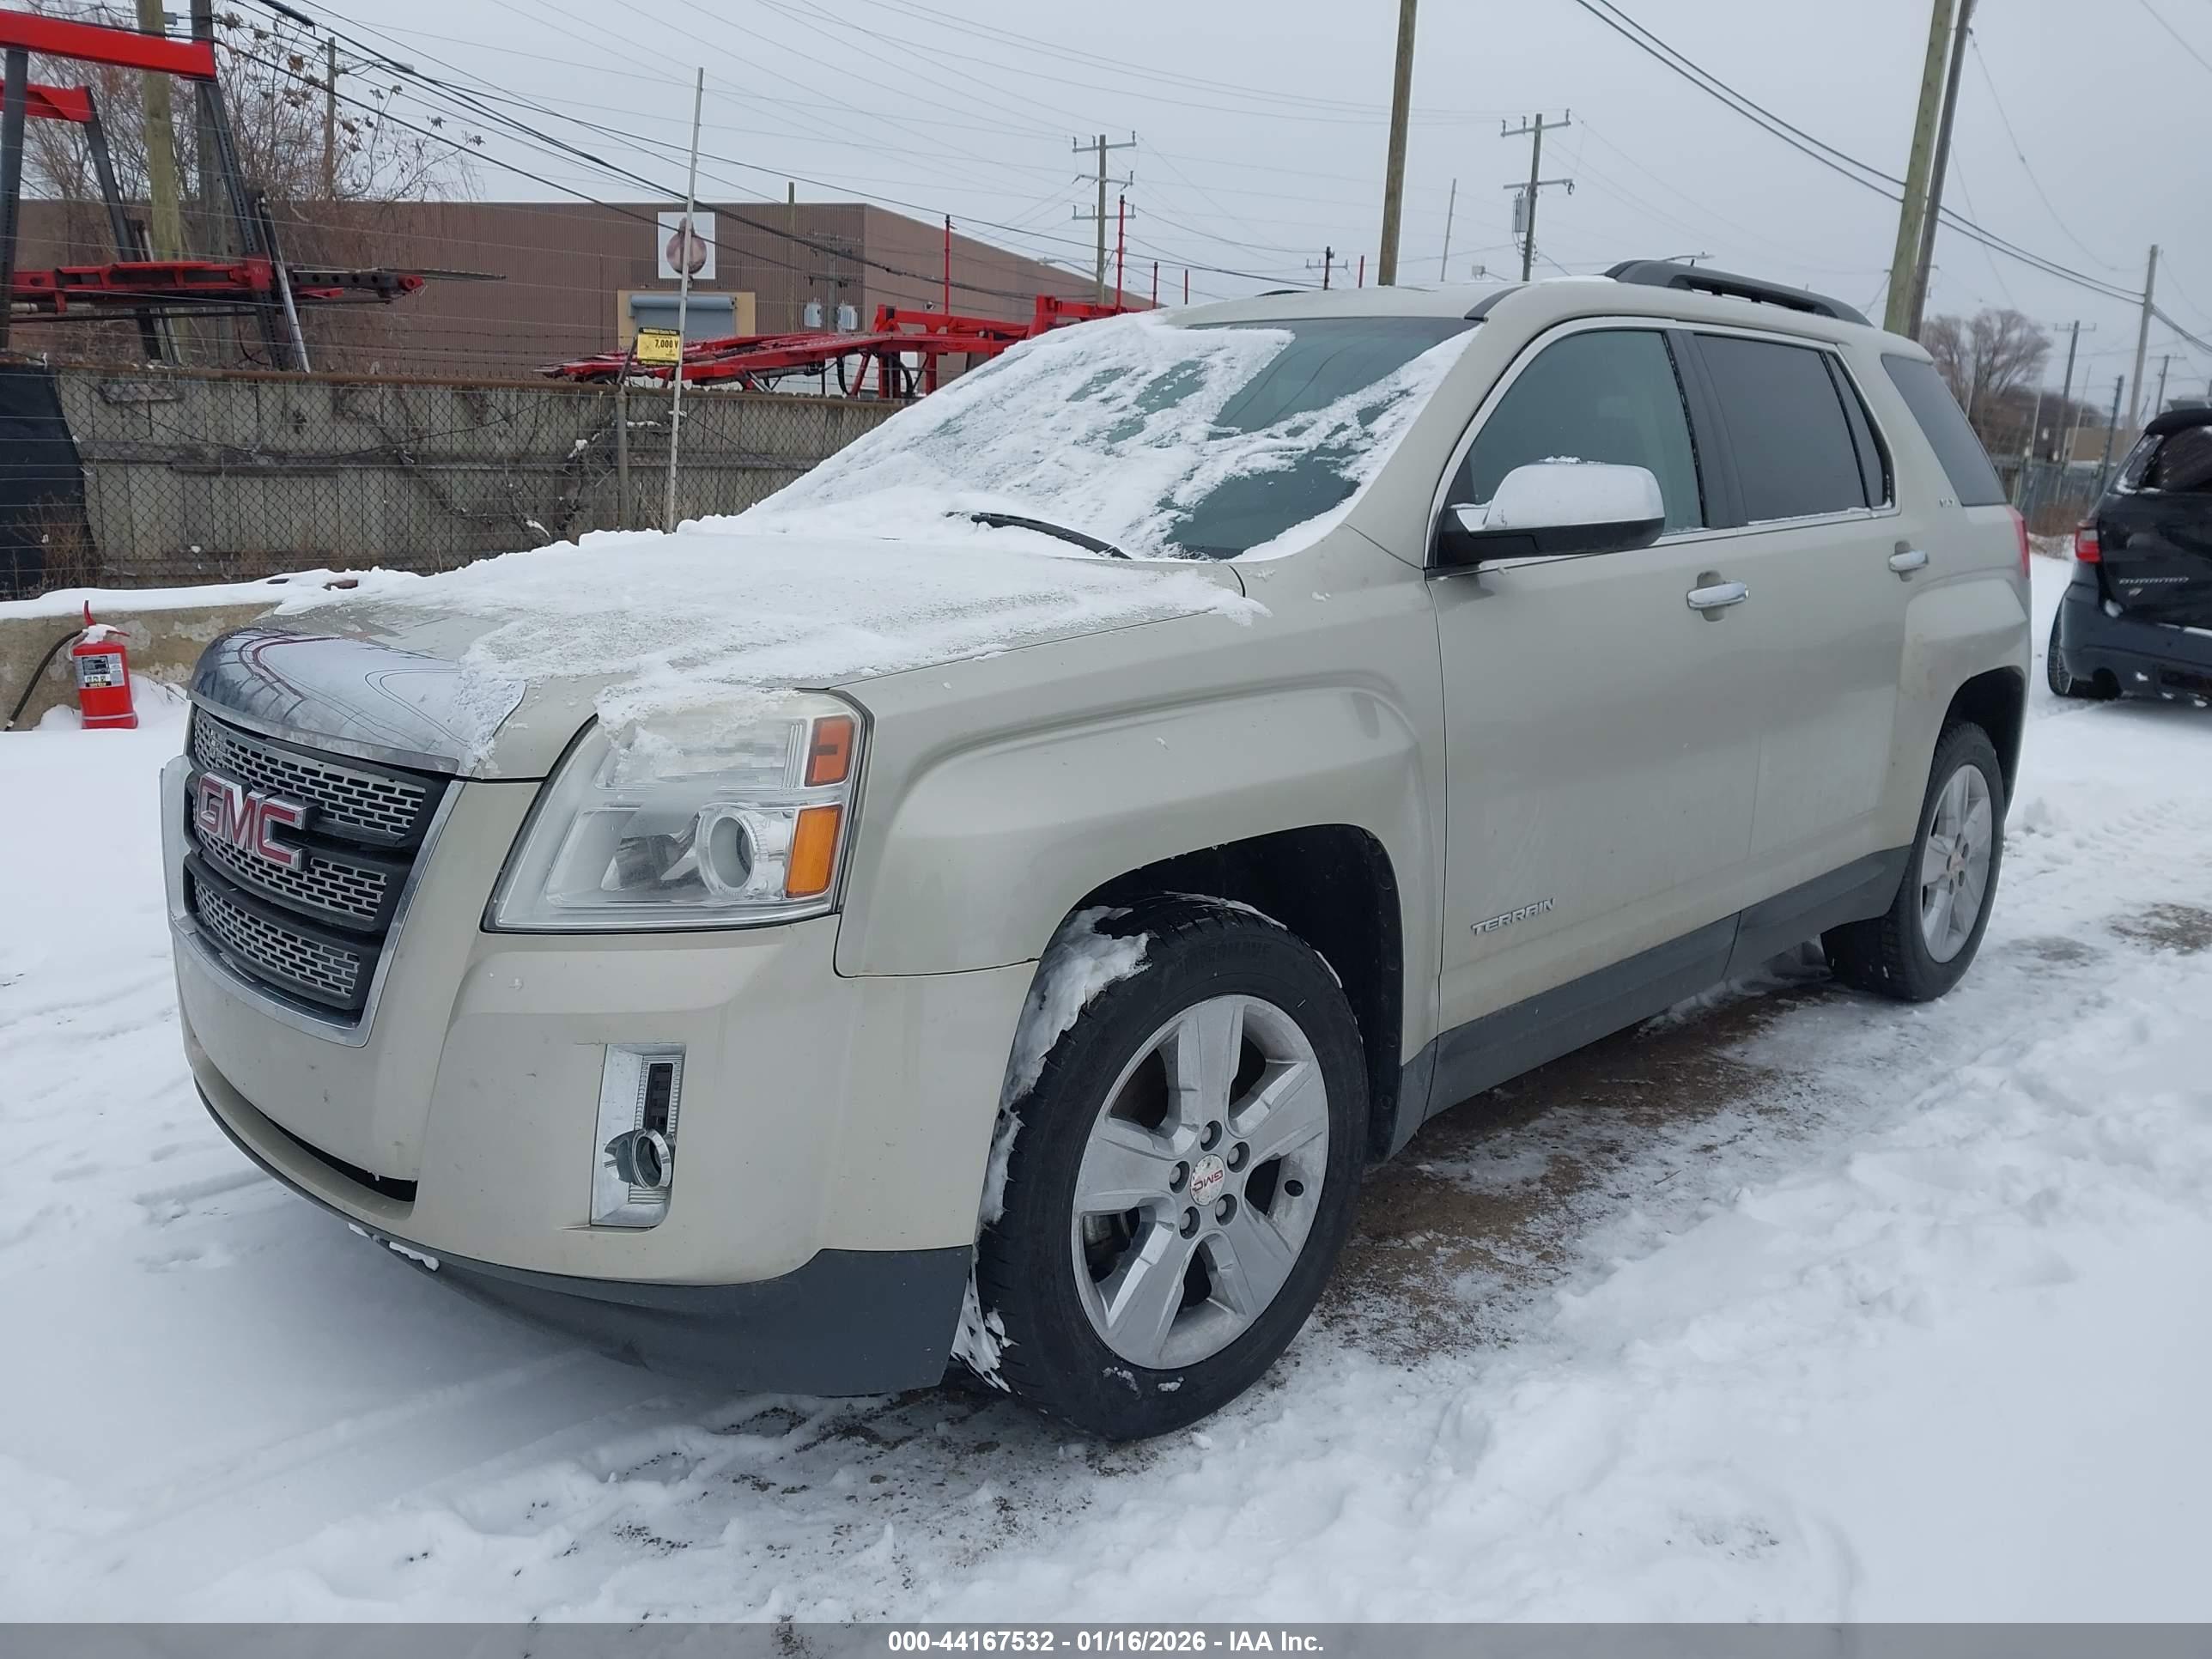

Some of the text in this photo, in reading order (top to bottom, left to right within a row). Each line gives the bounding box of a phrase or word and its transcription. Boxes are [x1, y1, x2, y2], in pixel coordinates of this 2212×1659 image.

[654, 338, 678, 349] 7,000 V
[198, 772, 306, 871] GMC
[1471, 898, 1555, 935] TERRAIN
[1192, 1170, 1224, 1192] GMC
